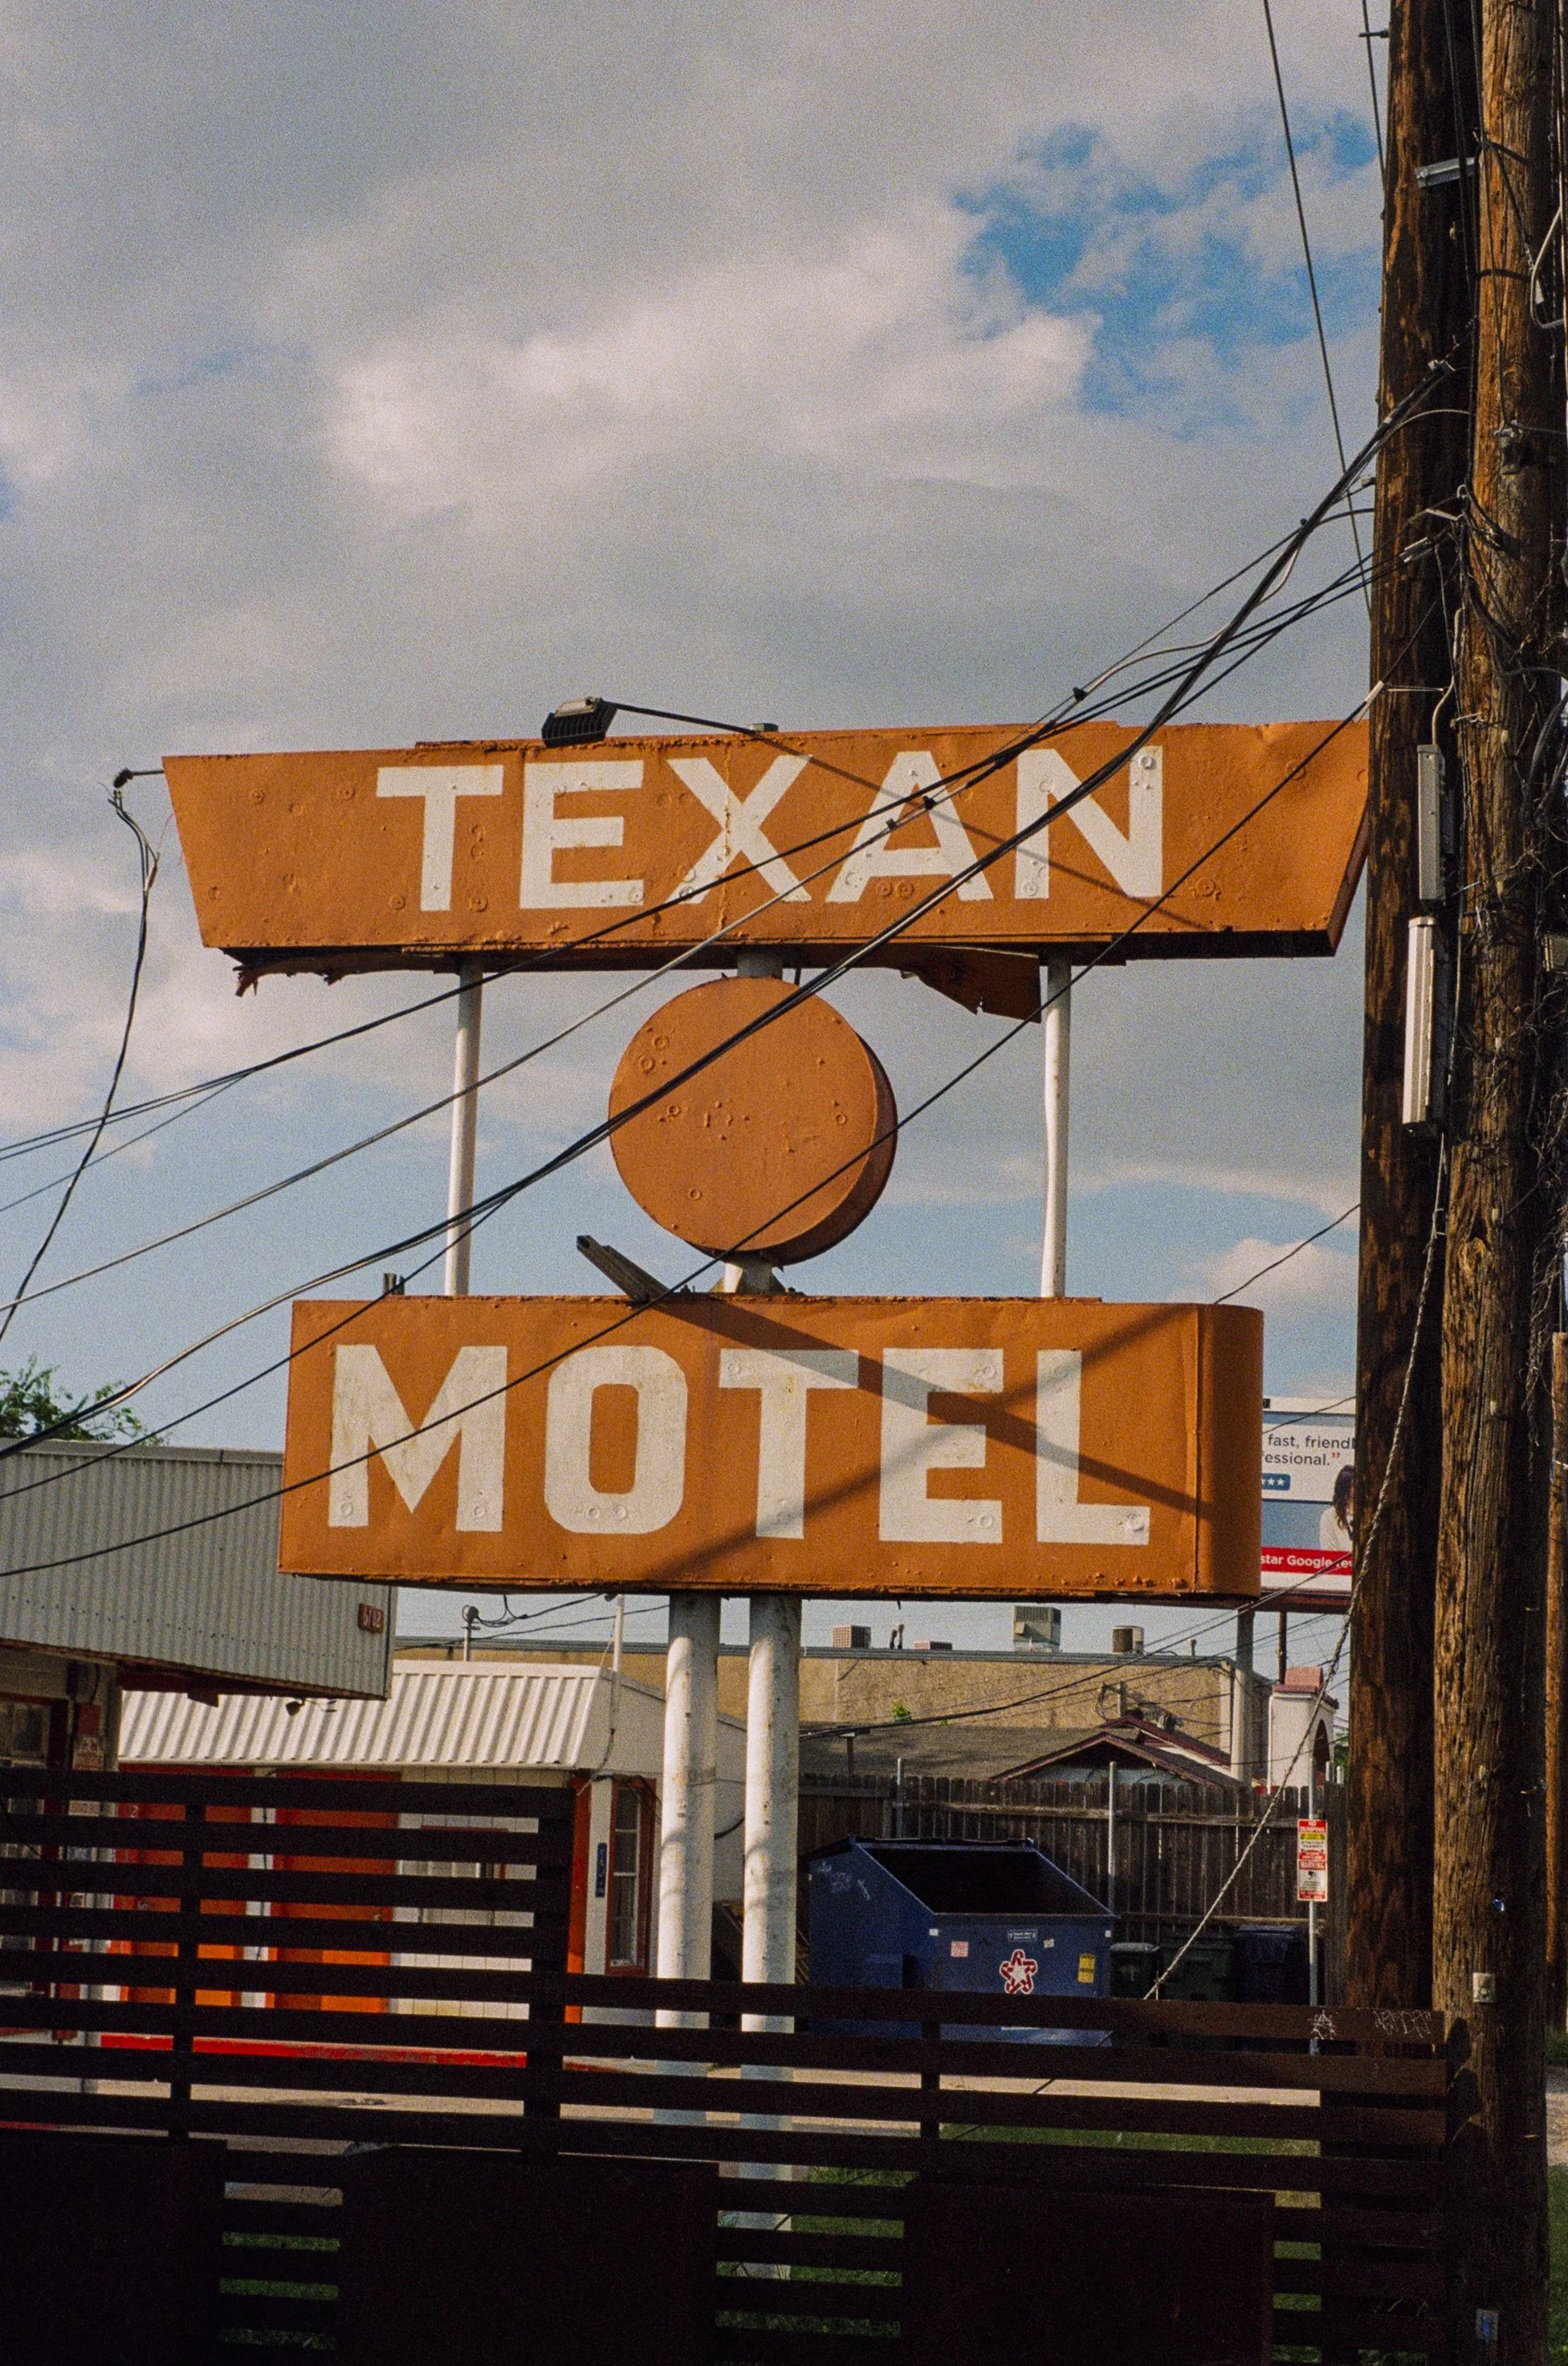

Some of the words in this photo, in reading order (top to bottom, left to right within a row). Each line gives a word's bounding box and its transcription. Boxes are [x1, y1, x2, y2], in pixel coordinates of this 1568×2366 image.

[377, 745, 1163, 912] TEXAN
[328, 1344, 1151, 1546] MOTEL
[1269, 1434, 1299, 1449] fast,
[1287, 1555, 1333, 1568] Google
